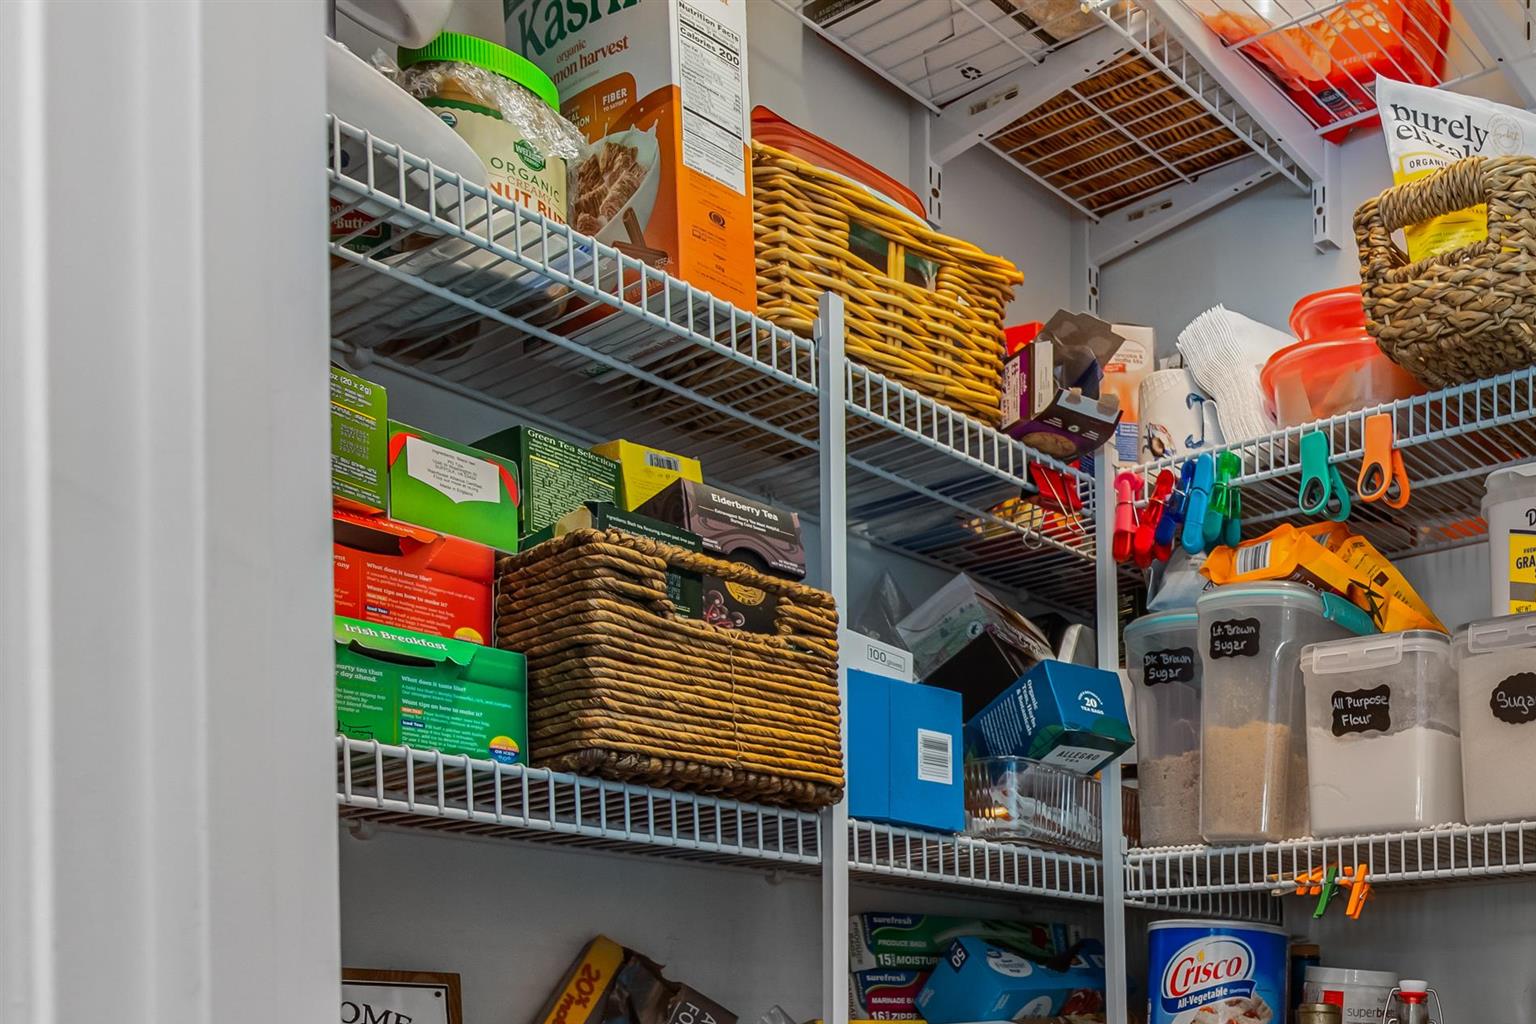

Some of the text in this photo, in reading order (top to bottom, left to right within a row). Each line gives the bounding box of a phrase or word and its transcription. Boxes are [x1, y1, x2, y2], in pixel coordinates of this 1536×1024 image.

[678, 1, 740, 43] Nutrition Facts
[556, 39, 587, 64] organic
[578, 35, 629, 70] harvest
[679, 26, 741, 67] Calories 200
[601, 87, 628, 107] FIBER
[1389, 103, 1490, 153] purely
[490, 157, 560, 204] ORGANIC
[527, 428, 618, 470] Green Tea Selection
[710, 493, 761, 518] Elderberry
[761, 509, 779, 522] Tea
[343, 623, 449, 651] Irish Breakfast
[1226, 624, 1257, 636] Brown
[868, 647, 888, 663] 100
[1162, 653, 1192, 666] Brown
[1148, 666, 1183, 681] Sugar
[1027, 679, 1039, 711] Organic
[1083, 696, 1098, 709] 20
[1345, 694, 1390, 708] Purpose
[1341, 712, 1373, 727] Flour
[1056, 750, 1101, 761] ALLEGRO
[872, 916, 912, 925] surefresh
[877, 939, 909, 947] PRODUCE
[877, 953, 892, 966] 15
[866, 974, 907, 982] surefresh
[1170, 955, 1243, 998] Crisco
[871, 997, 906, 1005] MARINADE
[1177, 985, 1229, 1010] All-Vegetable
